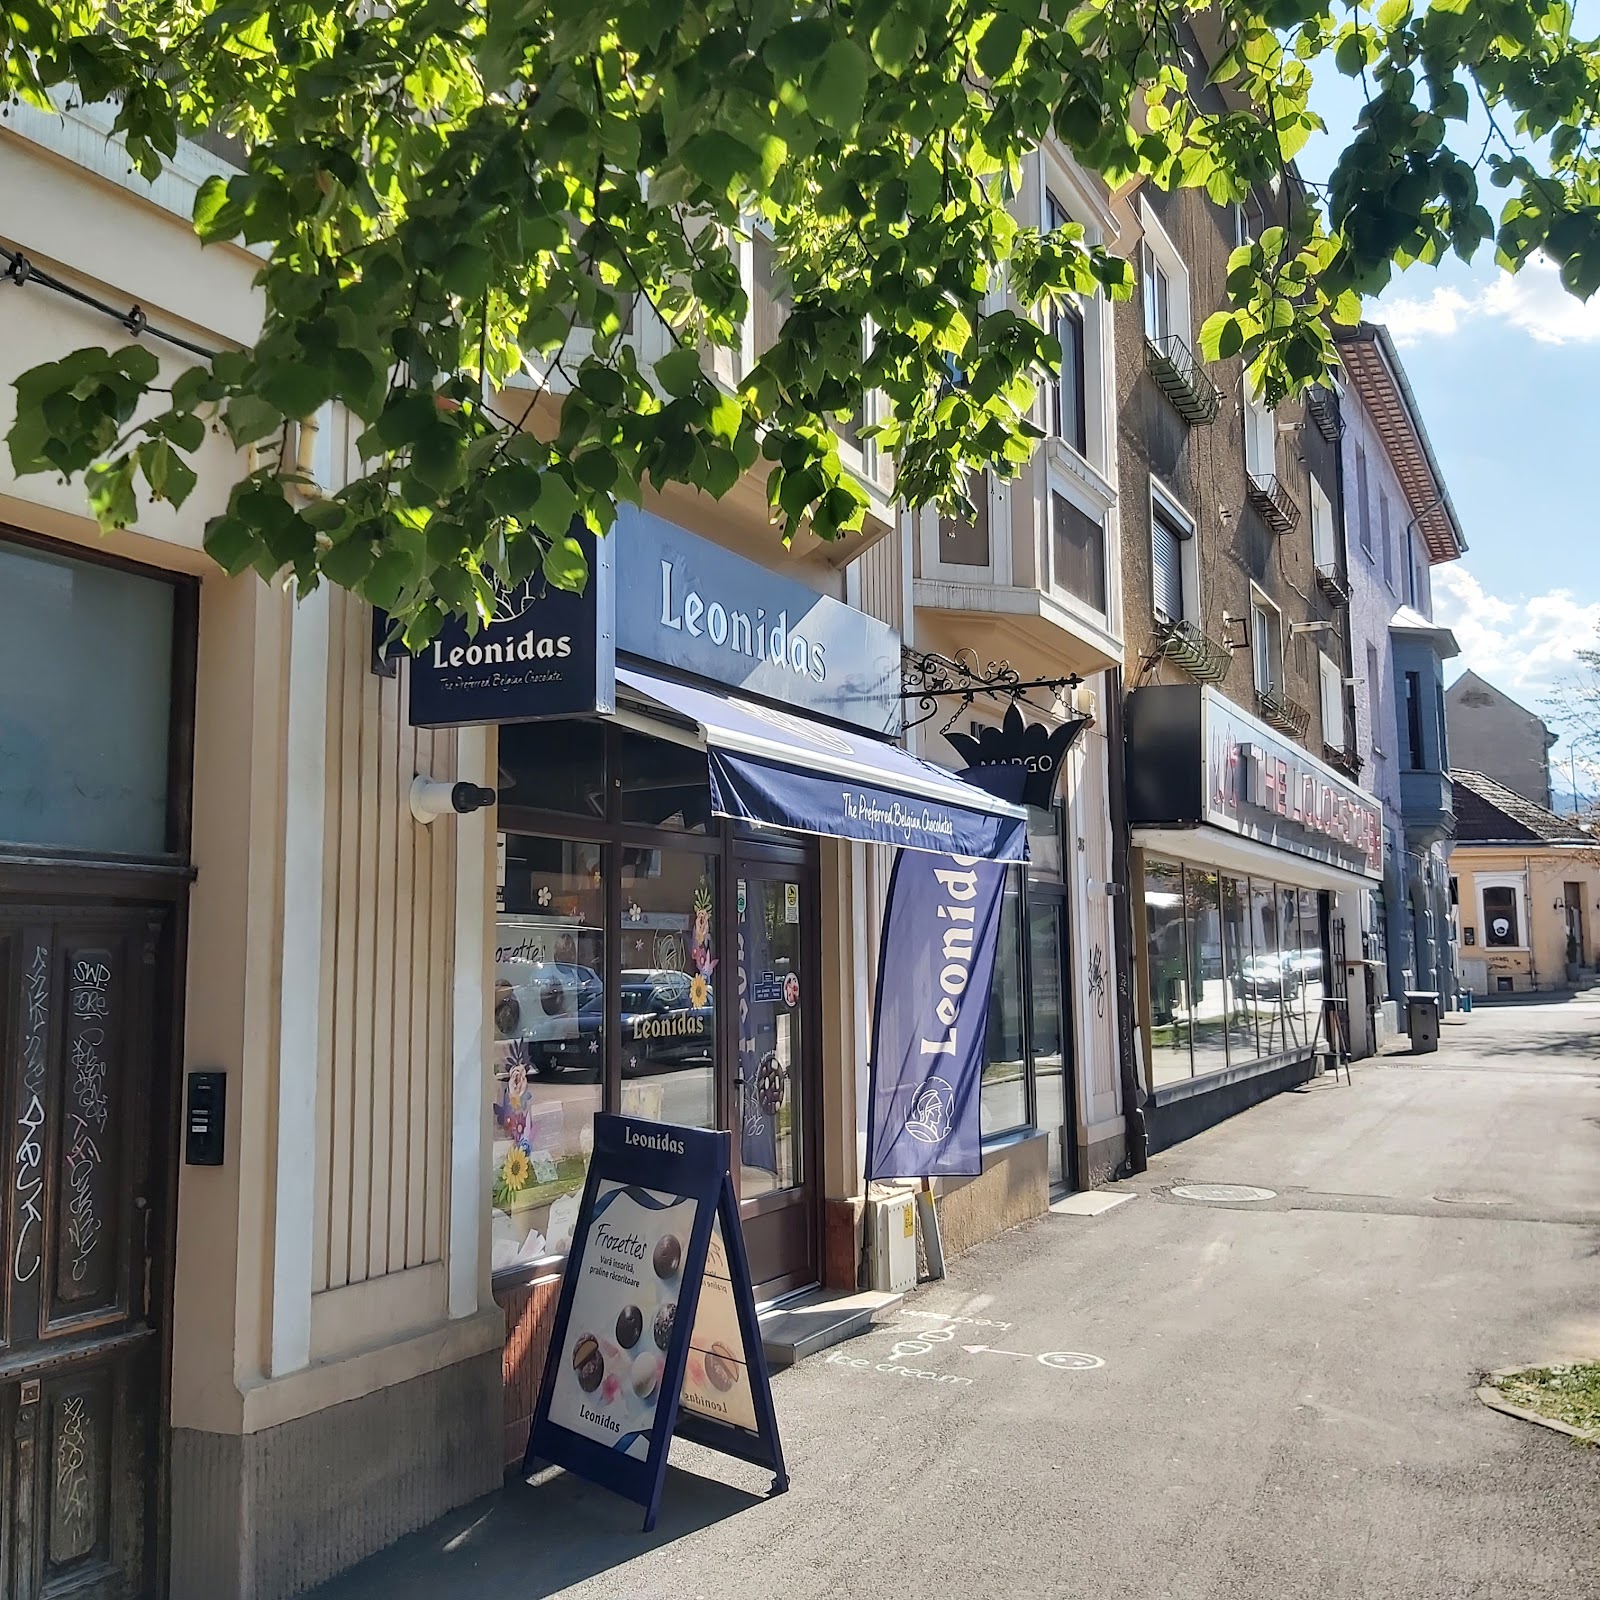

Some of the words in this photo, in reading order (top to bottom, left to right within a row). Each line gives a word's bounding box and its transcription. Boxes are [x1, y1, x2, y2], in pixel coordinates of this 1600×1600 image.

[661, 560, 826, 683] Leonidas
[433, 630, 572, 669] Leonidas
[842, 792, 857, 819] The
[859, 794, 894, 829] Preferred
[893, 803, 921, 840] Belgian
[921, 808, 953, 836] Chocolates
[633, 1011, 704, 1040] Leonidas
[625, 1126, 685, 1155] Leonidas
[595, 1223, 647, 1260] Frozettes
[589, 1266, 609, 1278] praline
[609, 1271, 640, 1288] răcoritoare
[875, 1363, 974, 1386] cream
[579, 1404, 620, 1433] Leonidas
